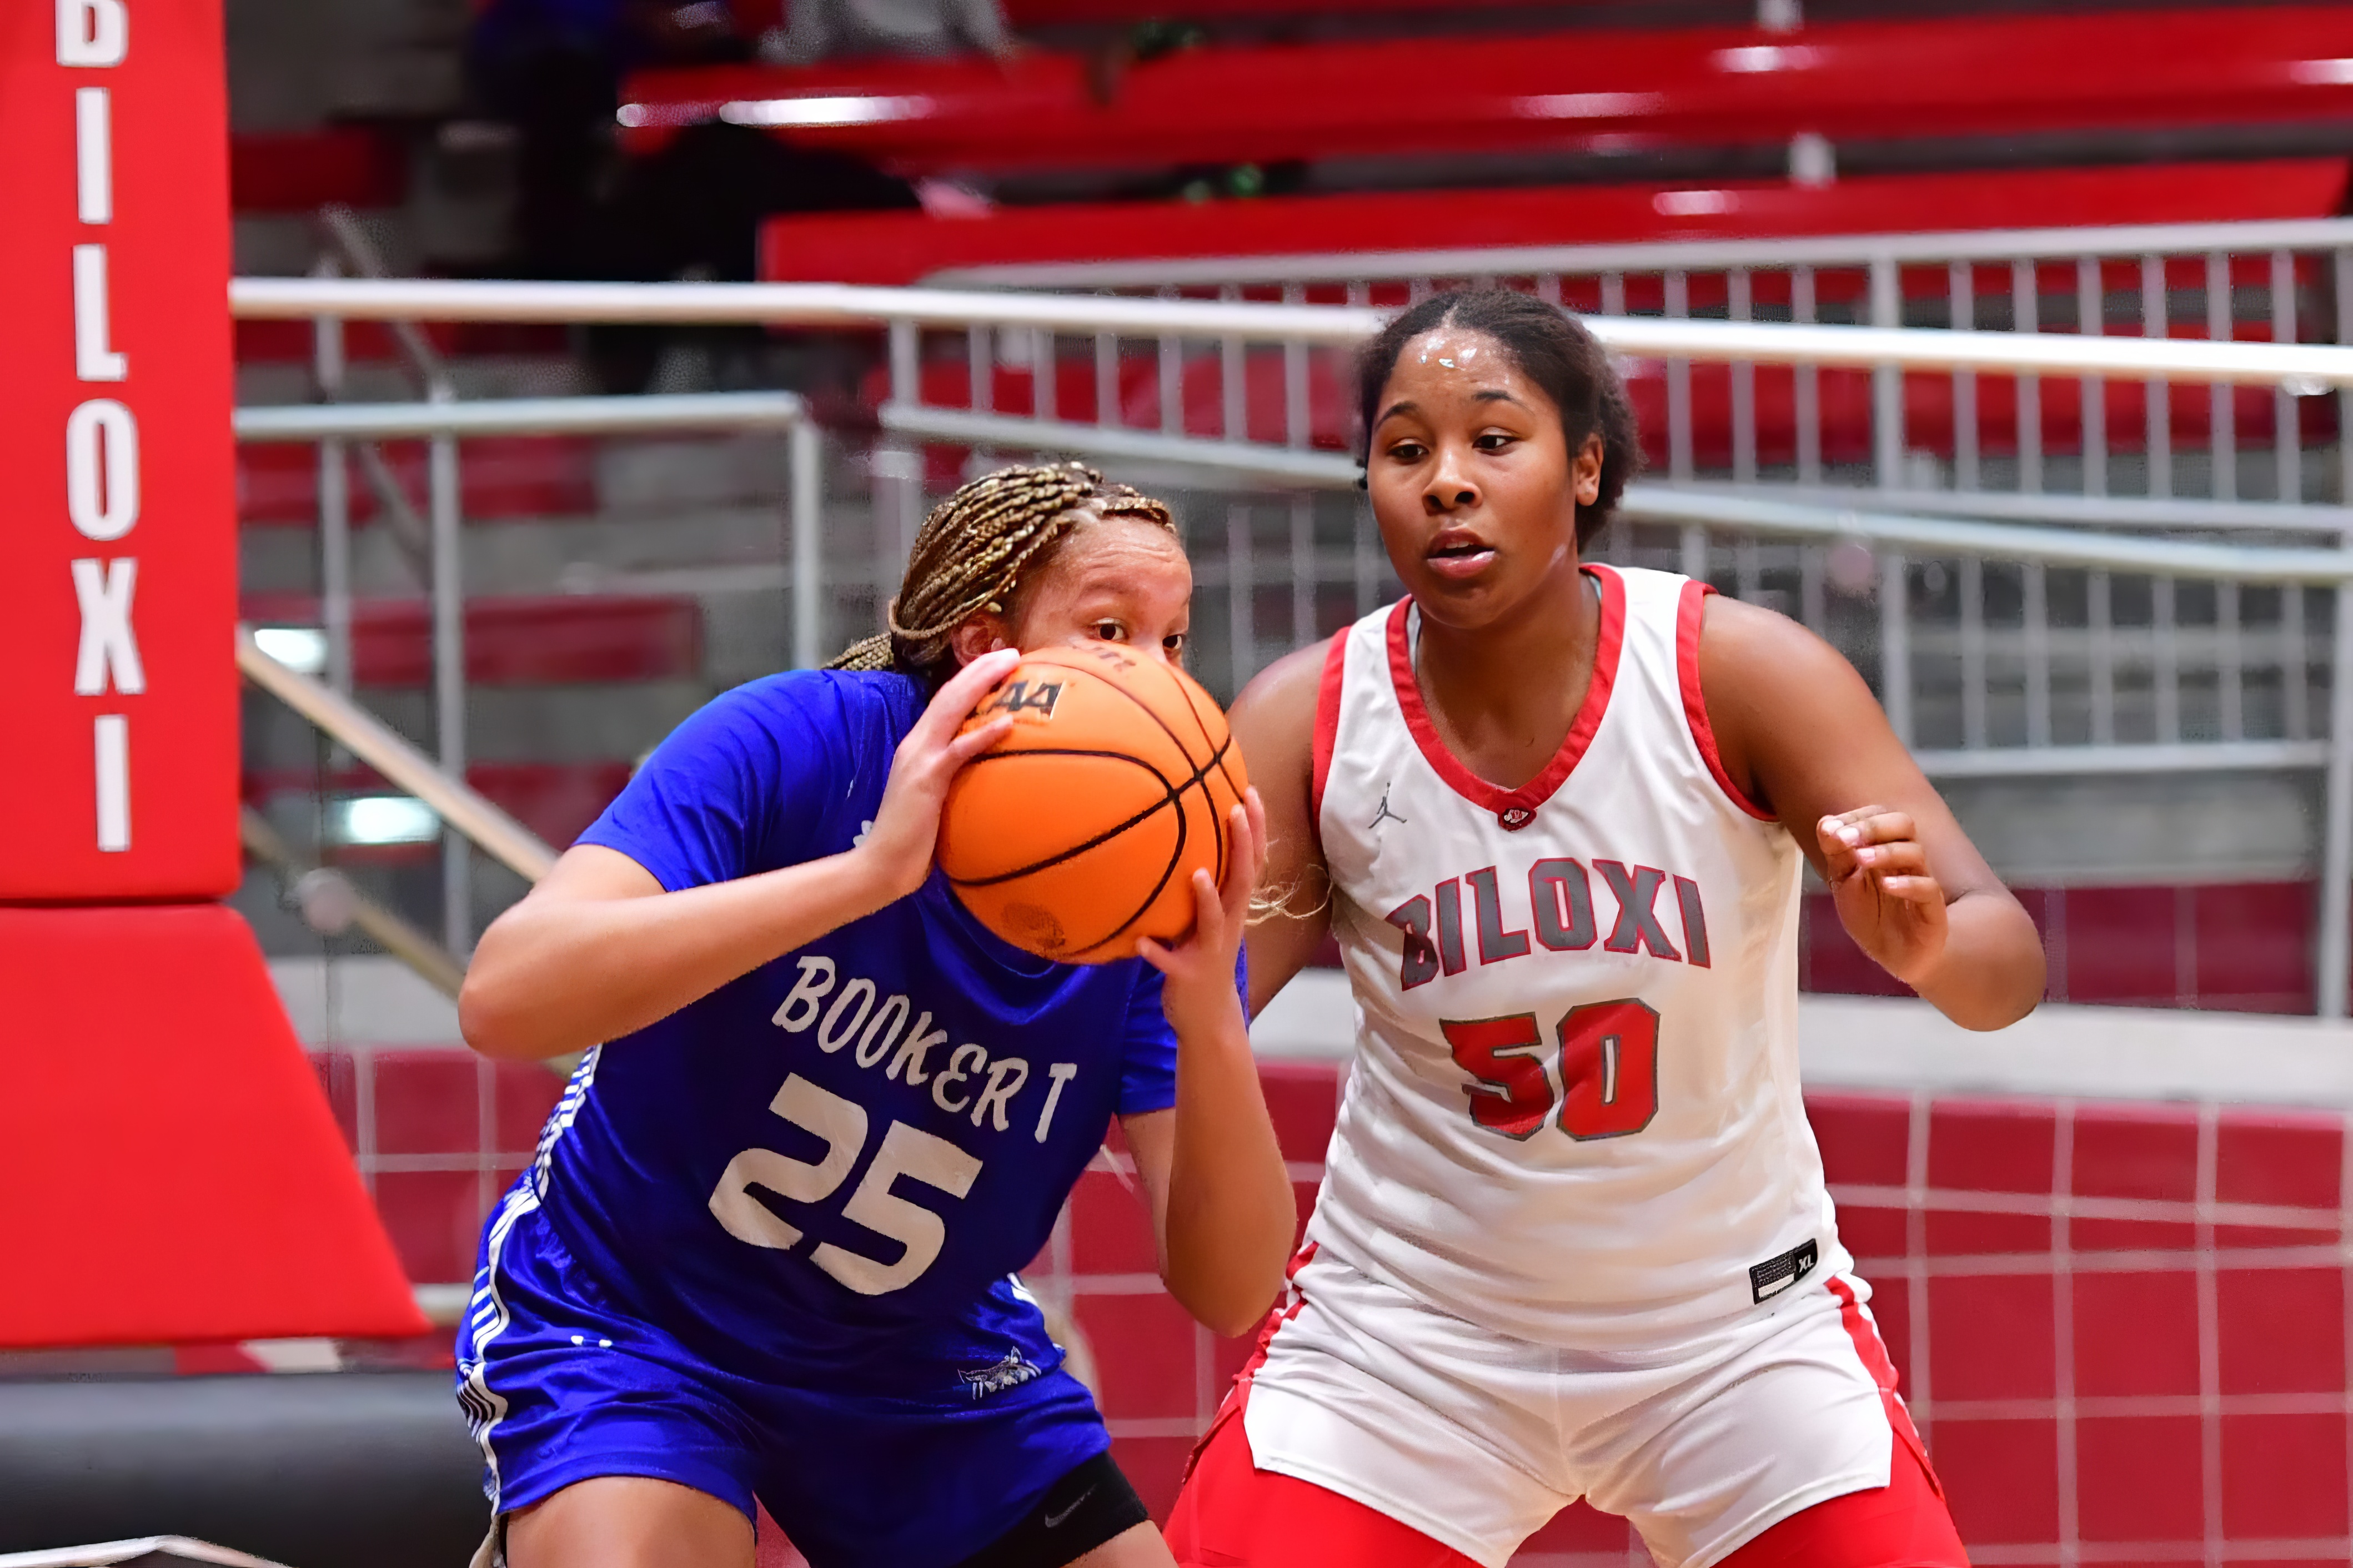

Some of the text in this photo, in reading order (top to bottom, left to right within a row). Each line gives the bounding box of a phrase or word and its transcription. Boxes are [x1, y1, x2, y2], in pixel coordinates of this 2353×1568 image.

[1385, 857, 1711, 992] BILOXI
[772, 956, 1077, 1143] BOOKER T
[1439, 997, 1660, 1142] 50
[708, 1072, 983, 1295] 25
[1798, 1254, 1814, 1273] XL
